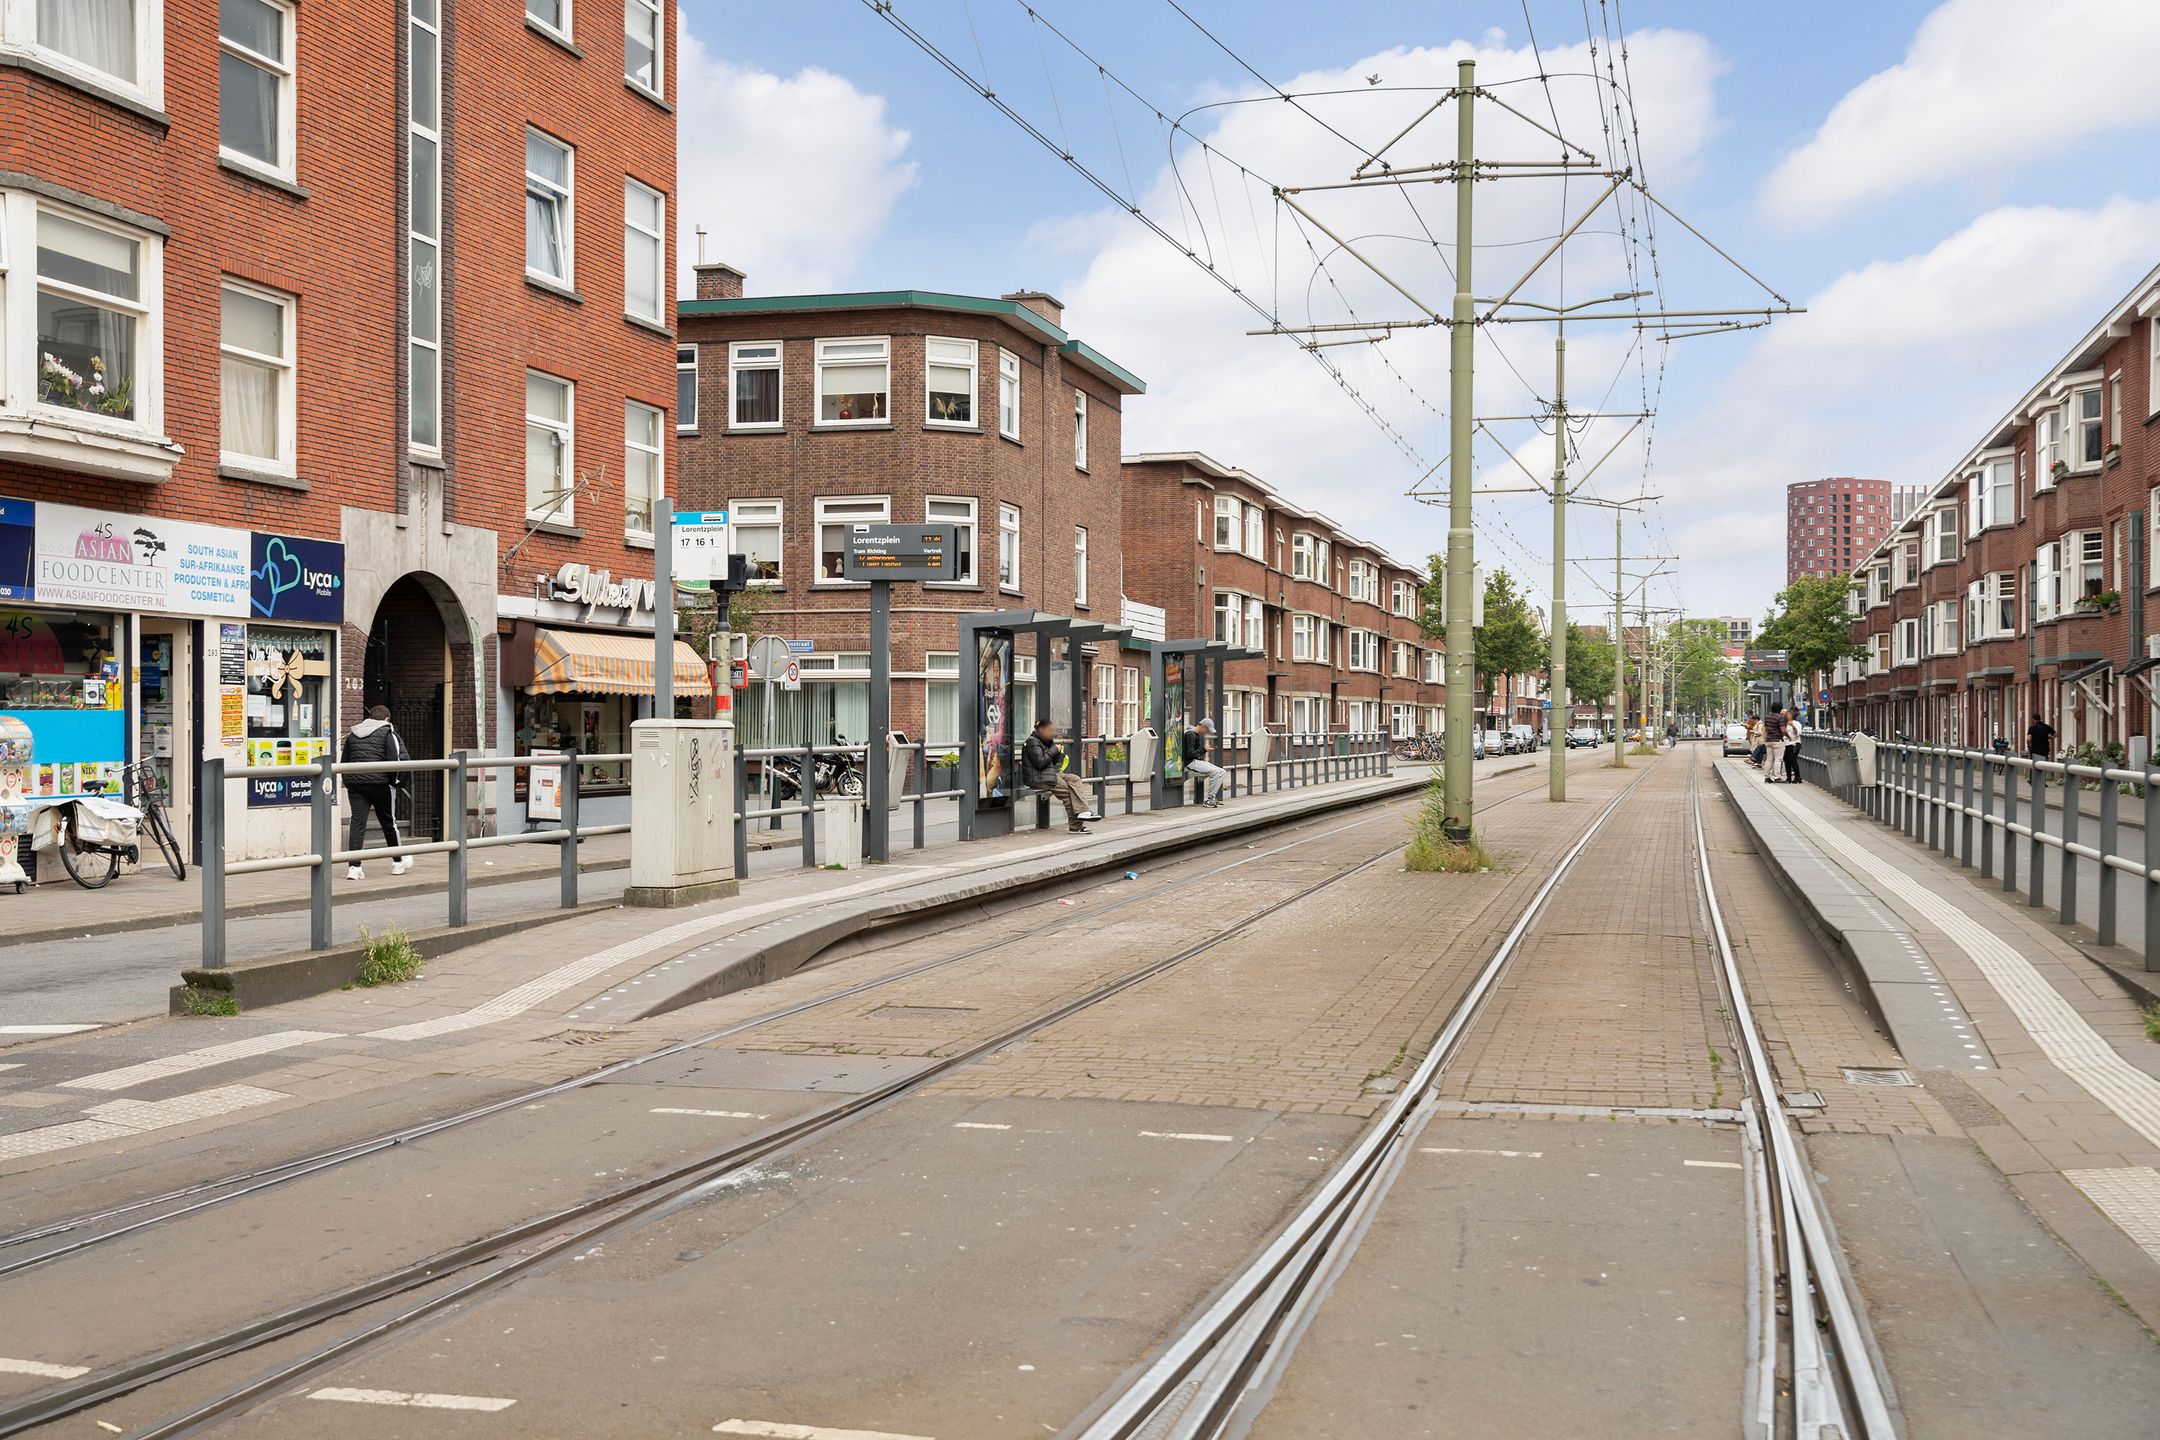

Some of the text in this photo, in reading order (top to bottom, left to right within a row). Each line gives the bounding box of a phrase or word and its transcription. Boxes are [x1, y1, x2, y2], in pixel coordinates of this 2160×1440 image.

[94, 522, 113, 539] 4S
[681, 537, 714, 546] 17 16 1
[853, 536, 900, 545] Lorentzplein
[77, 539, 130, 561] ASIAN
[188, 544, 238, 560] SOUTH ASIAN
[42, 560, 165, 589] FOODCENTER
[179, 558, 246, 576] SUR-AFRIKAANSE
[174, 574, 250, 590] PRODUCTEN & AFRO
[303, 567, 332, 590] Lyca
[37, 586, 166, 608] WWW.ASIANFOODCENTER.NL
[190, 590, 235, 604] COSMETICA
[315, 588, 332, 597] Mobile
[5, 615, 33, 640] 4S
[790, 668, 796, 676] 30
[345, 677, 364, 690] 263
[255, 780, 277, 795] Lyca
[291, 791, 301, 799] your
